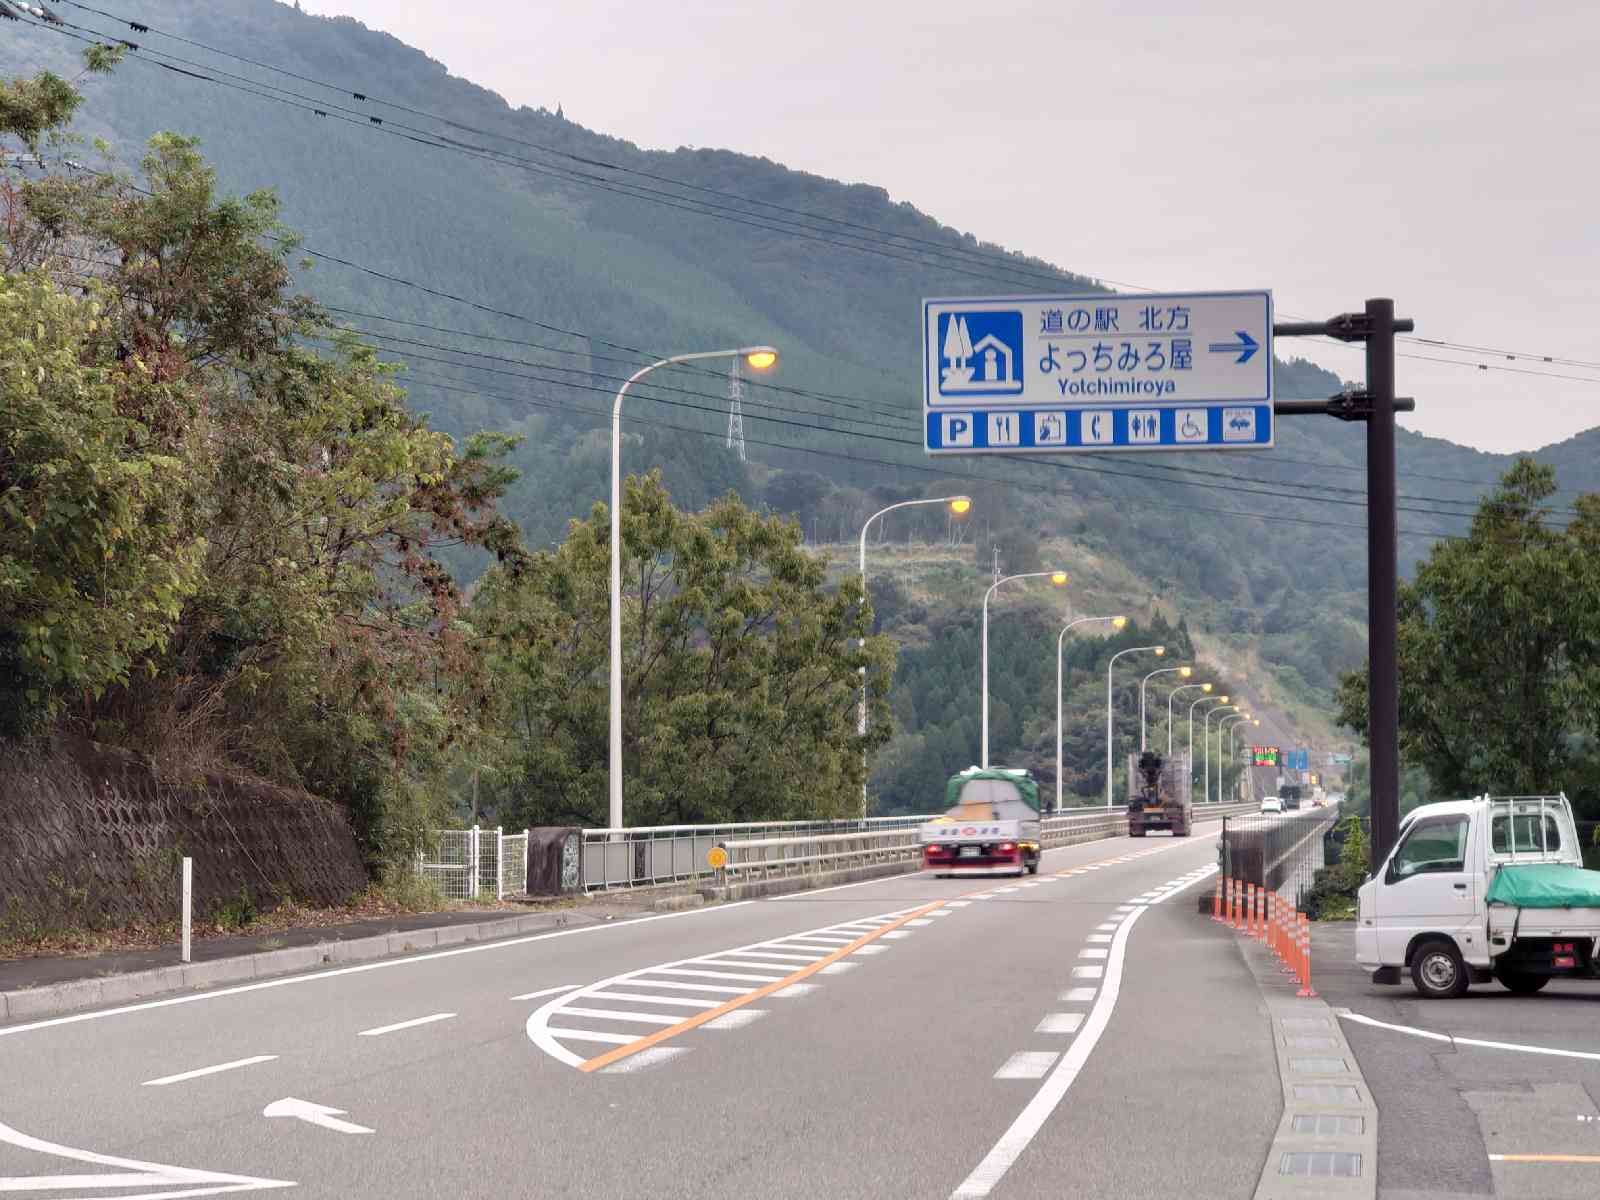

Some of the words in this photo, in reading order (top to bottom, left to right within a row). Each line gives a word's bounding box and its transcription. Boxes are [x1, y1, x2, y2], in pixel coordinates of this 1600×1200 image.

[1040, 308, 1120, 333] 道の駅
[1139, 305, 1191, 331] 北方
[1039, 340, 1193, 373] よっちみろ屋
[1058, 377, 1176, 396] Yotchimiroya
[949, 419, 968, 441] P
